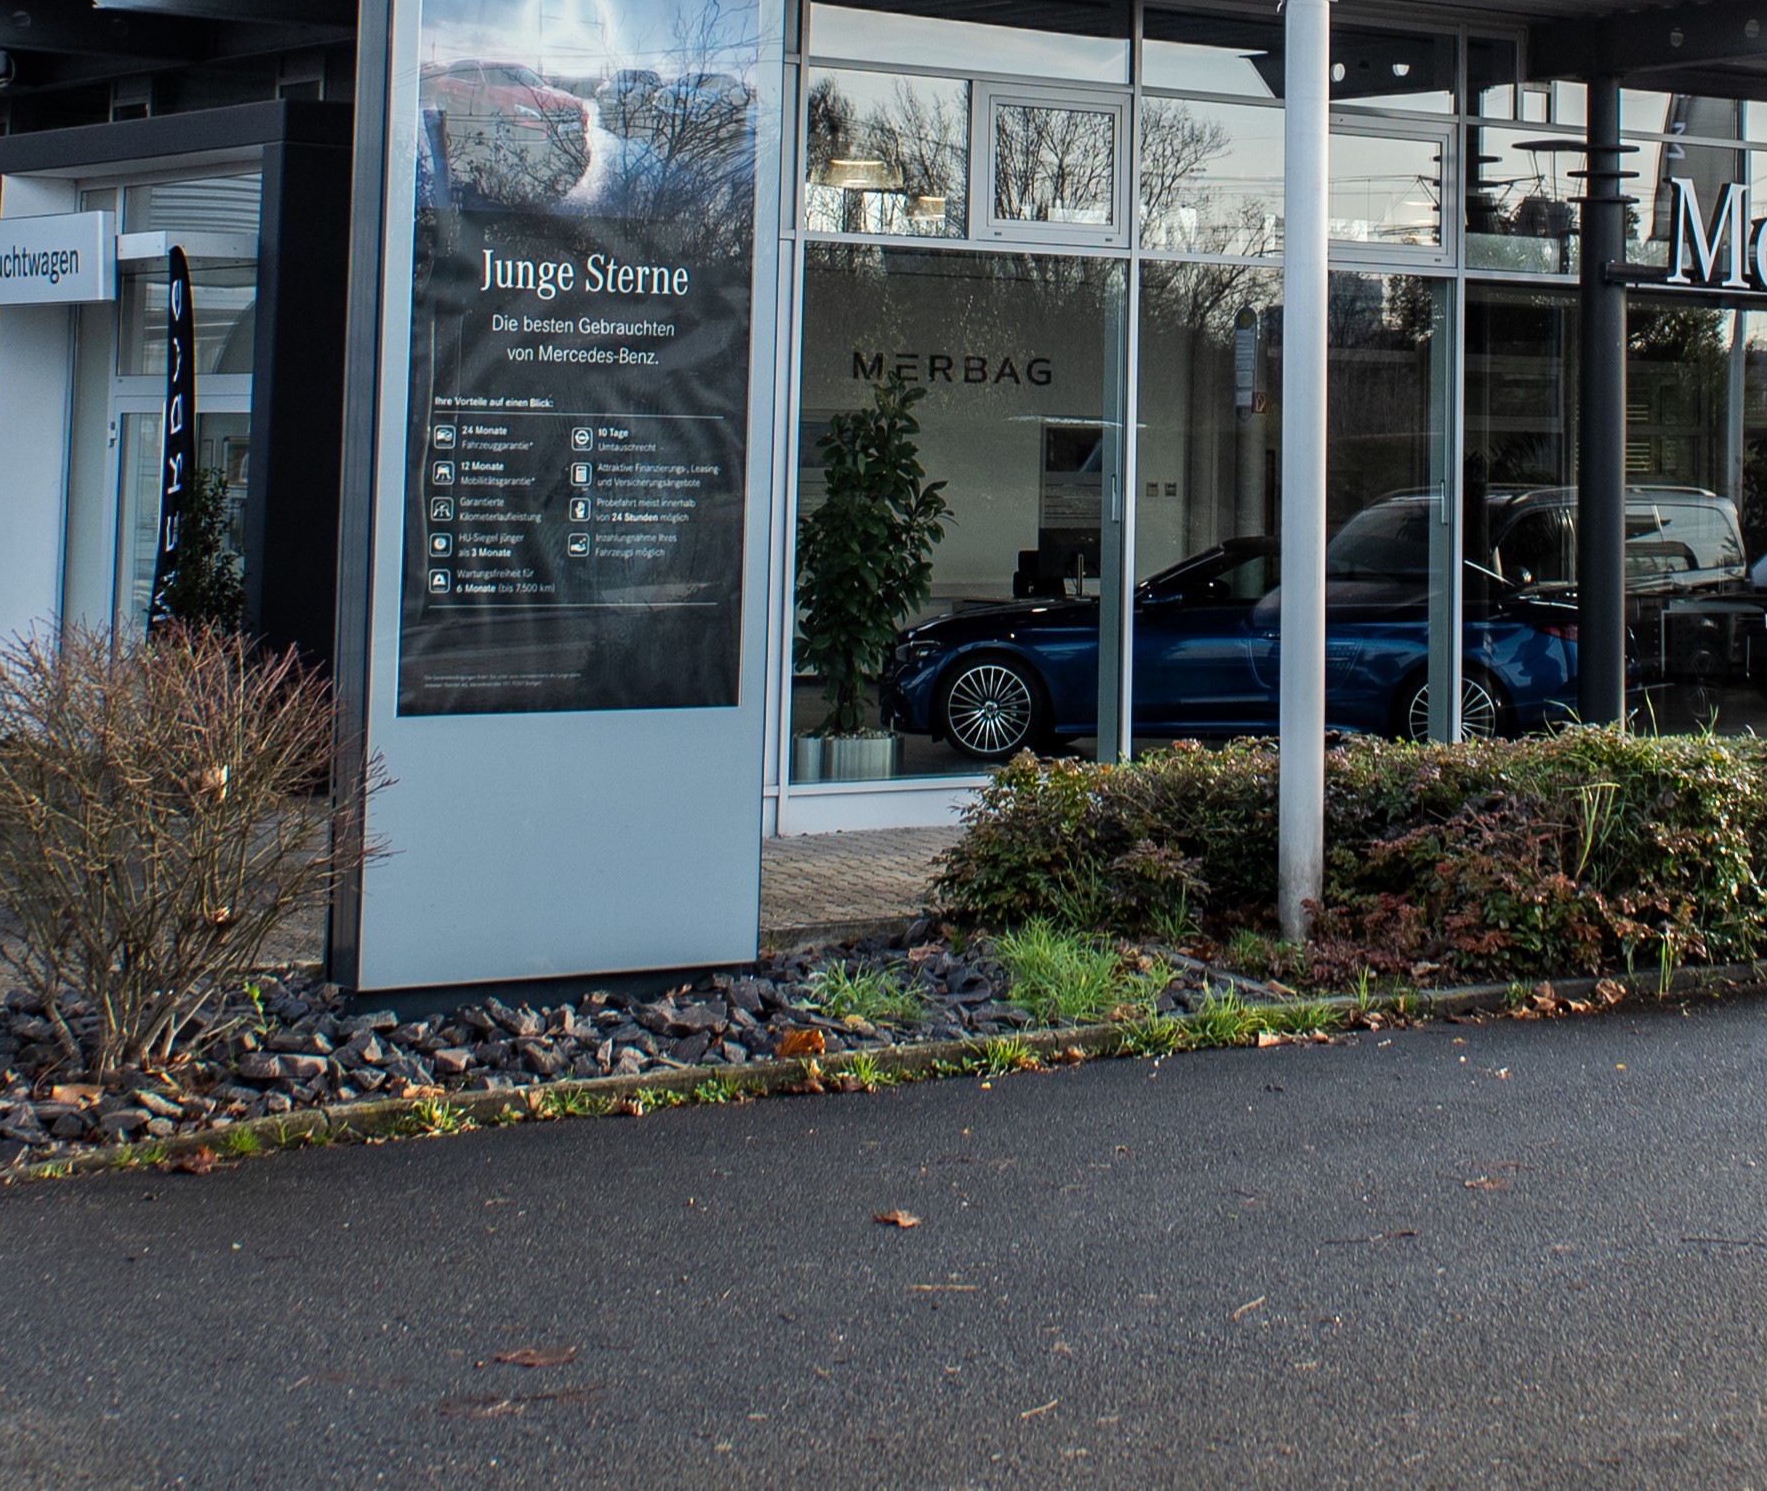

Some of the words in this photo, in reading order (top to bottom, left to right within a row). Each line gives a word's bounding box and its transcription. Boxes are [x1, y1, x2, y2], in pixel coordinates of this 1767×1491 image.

[480, 248, 574, 300] Junge
[585, 253, 689, 296] Sterne
[492, 314, 518, 332] Die
[523, 315, 574, 334] besten
[578, 317, 675, 337] Gebrauchten
[507, 348, 534, 361] von
[538, 345, 659, 365] Mercedes-Benz.
[852, 352, 1053, 387] MERBAG
[435, 397, 453, 406] Ihre
[455, 397, 487, 406] Vorteile
[489, 397, 504, 407] auf
[505, 398, 528, 407] einen
[461, 426, 474, 435] 24
[475, 425, 507, 435] Monate
[609, 428, 629, 439] Tage
[472, 462, 504, 471] Monate
[611, 513, 622, 522] 24
[479, 548, 511, 557] Monate
[465, 584, 496, 593] Monate
